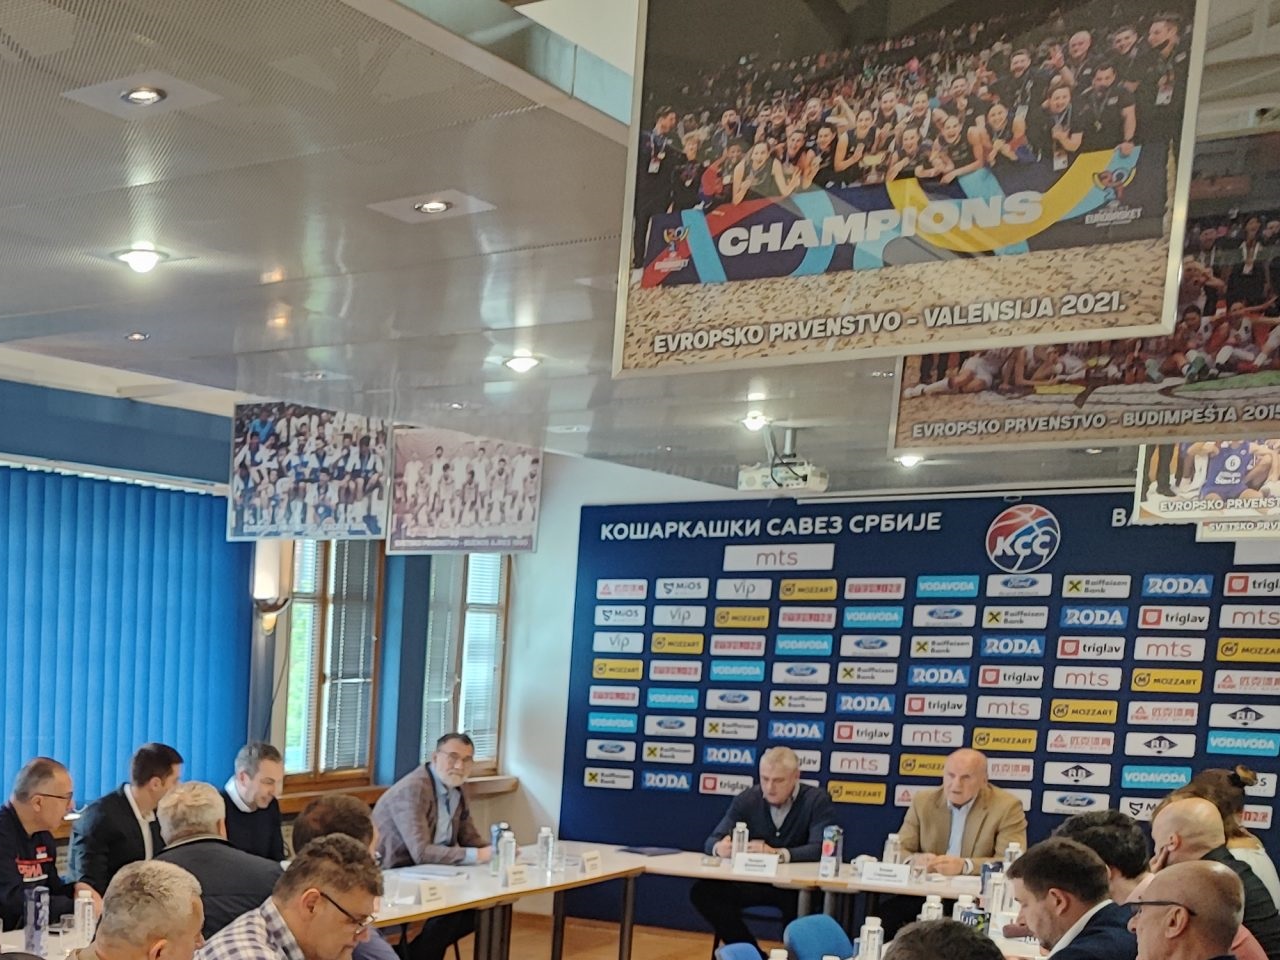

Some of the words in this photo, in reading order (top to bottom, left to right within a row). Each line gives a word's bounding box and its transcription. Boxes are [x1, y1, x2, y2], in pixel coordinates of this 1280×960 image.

[718, 190, 1043, 257] CHAMPIONS
[653, 325, 764, 353] EVROPSKO
[769, 311, 902, 342] PRVENSTVO
[923, 297, 1055, 328] VALENSIJA
[1060, 291, 1126, 316] 2021.
[912, 420, 1001, 438] EVROPSKO
[1004, 413, 1107, 433] PRVENSTVO
[1122, 403, 1238, 427] BUDIMPEŠTA
[1160, 499, 1224, 513] EVROPSKO
[1226, 498, 1280, 510] PRVENST
[600, 519, 761, 541] КОШАРКАШКИ
[766, 515, 843, 536] САВЕЗ
[849, 512, 942, 533] СРБИЈЕ
[756, 550, 798, 566] mts
[1147, 578, 1209, 594] RODA
[1252, 579, 1280, 592] trigl
[1066, 608, 1124, 625] RODA
[1165, 611, 1205, 626] triglav
[1232, 608, 1280, 626] mts
[985, 638, 1042, 655] RODA
[1082, 641, 1121, 656] triglav
[1146, 641, 1192, 657] mts
[1241, 647, 1280, 655] MOZZAR
[913, 668, 966, 684] RODA
[1003, 671, 1040, 685] triglav
[1065, 671, 1109, 687] mts
[1153, 678, 1197, 686] MOZZART
[841, 696, 891, 712] RODA
[928, 698, 963, 713] triglav
[987, 700, 1030, 716] mts
[1071, 709, 1113, 717] MOZZART
[773, 723, 821, 738] RODA
[856, 725, 889, 739] triglav
[912, 728, 952, 744] mts
[992, 737, 1032, 745] MOZZART
[1210, 738, 1275, 750] VODAVODA
[707, 748, 754, 763] RODA
[798, 755, 818, 767] glav
[840, 757, 878, 772] mts
[645, 773, 690, 789] RODA
[1125, 772, 1186, 783] VODAVODA
